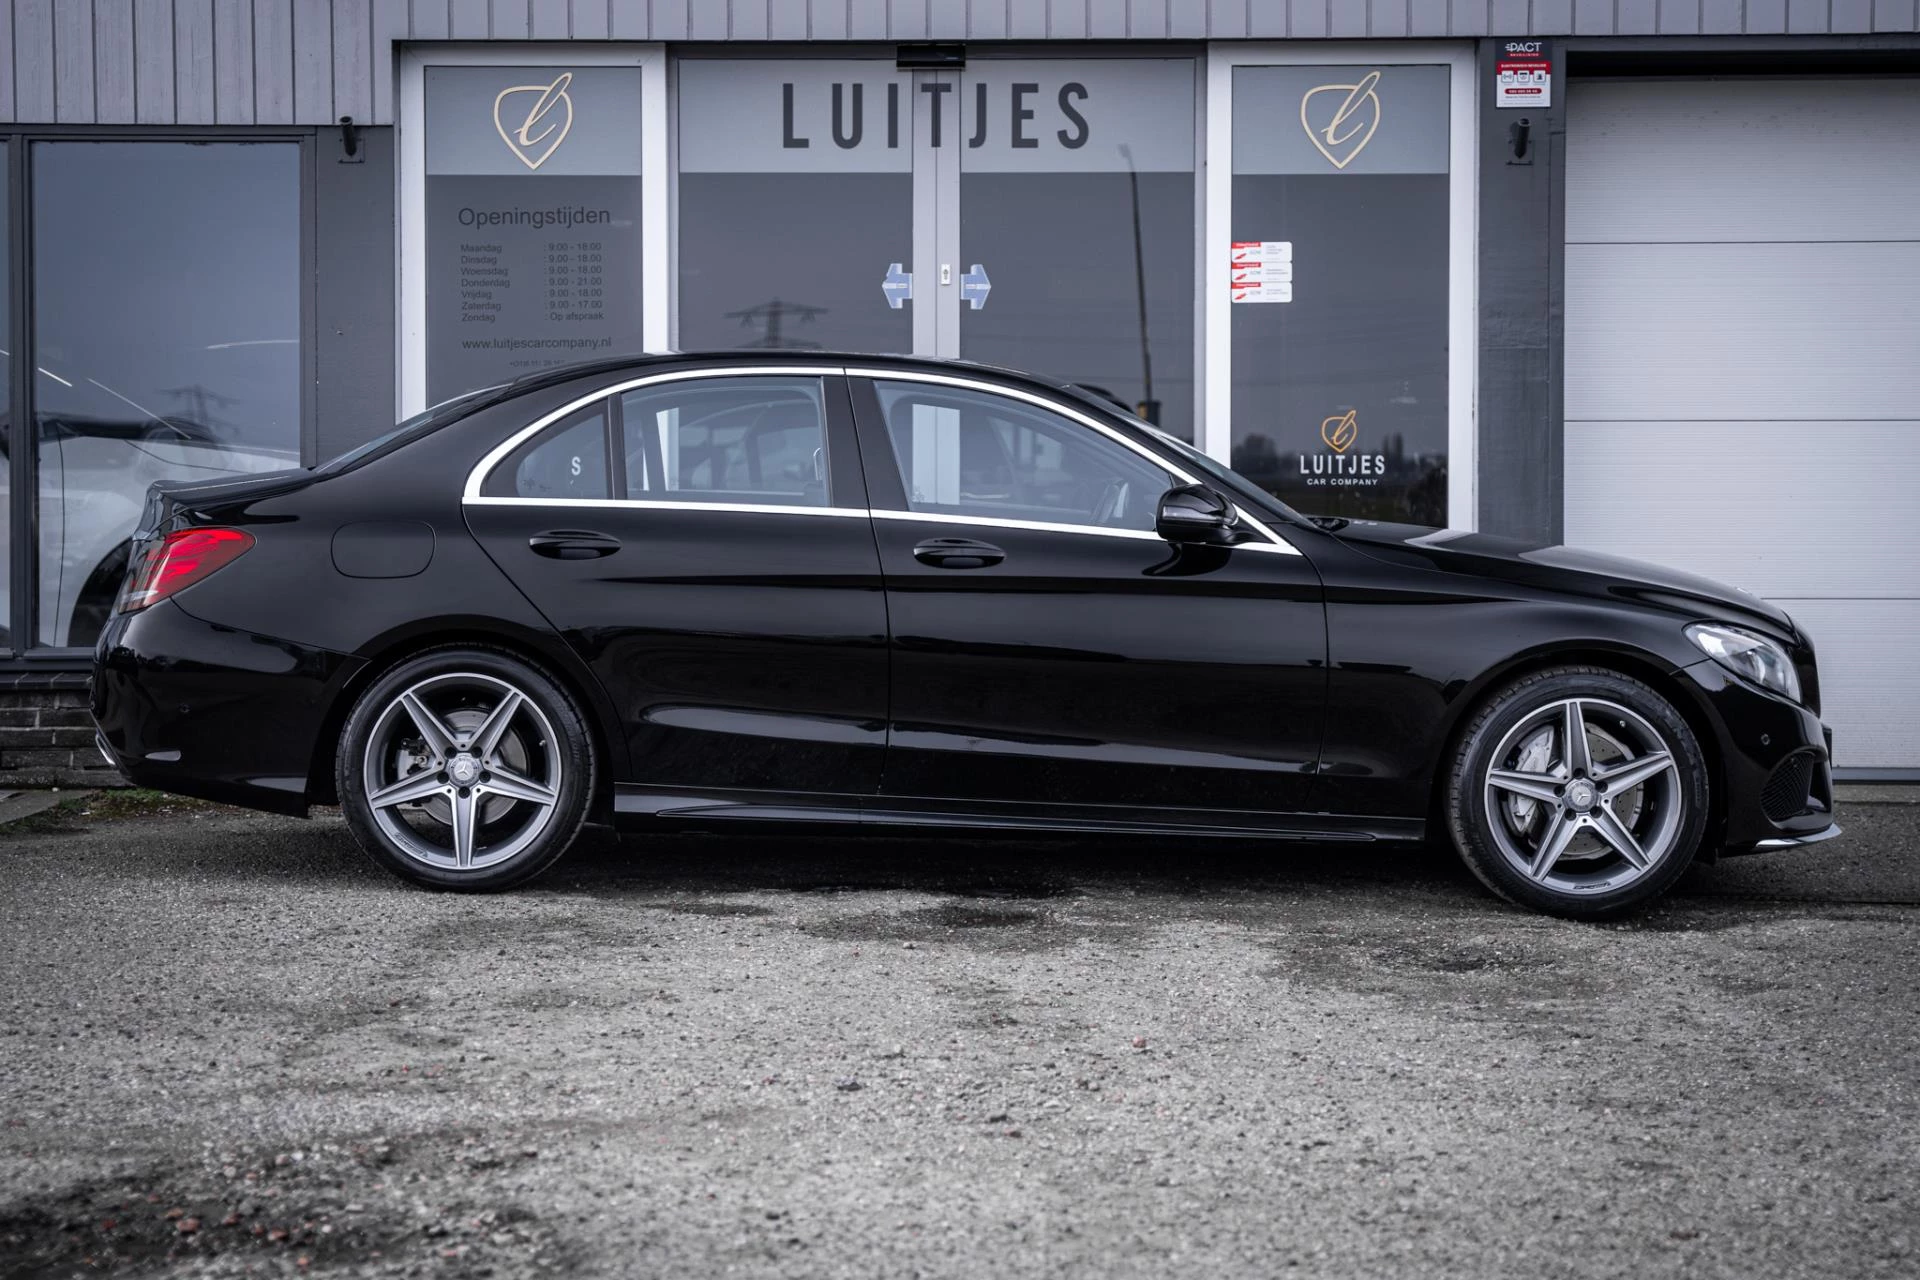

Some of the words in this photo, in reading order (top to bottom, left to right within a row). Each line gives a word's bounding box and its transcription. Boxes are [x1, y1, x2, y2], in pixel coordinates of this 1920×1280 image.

[782, 82, 1089, 150] LUITJES
[458, 206, 611, 229] Openingstijden
[460, 244, 502, 254] Maandag
[461, 255, 497, 266] Dinsdag
[461, 267, 509, 277] Woensdag
[461, 278, 511, 288] Donderdag
[461, 290, 492, 300] Vrijdag
[462, 301, 502, 312] Zaterdag
[462, 313, 496, 323] Zondag
[550, 312, 563, 322] Op
[565, 311, 605, 321] afspraak
[462, 336, 612, 351] www.luitjescarcompany.nl
[1300, 455, 1385, 475] LUITJES
